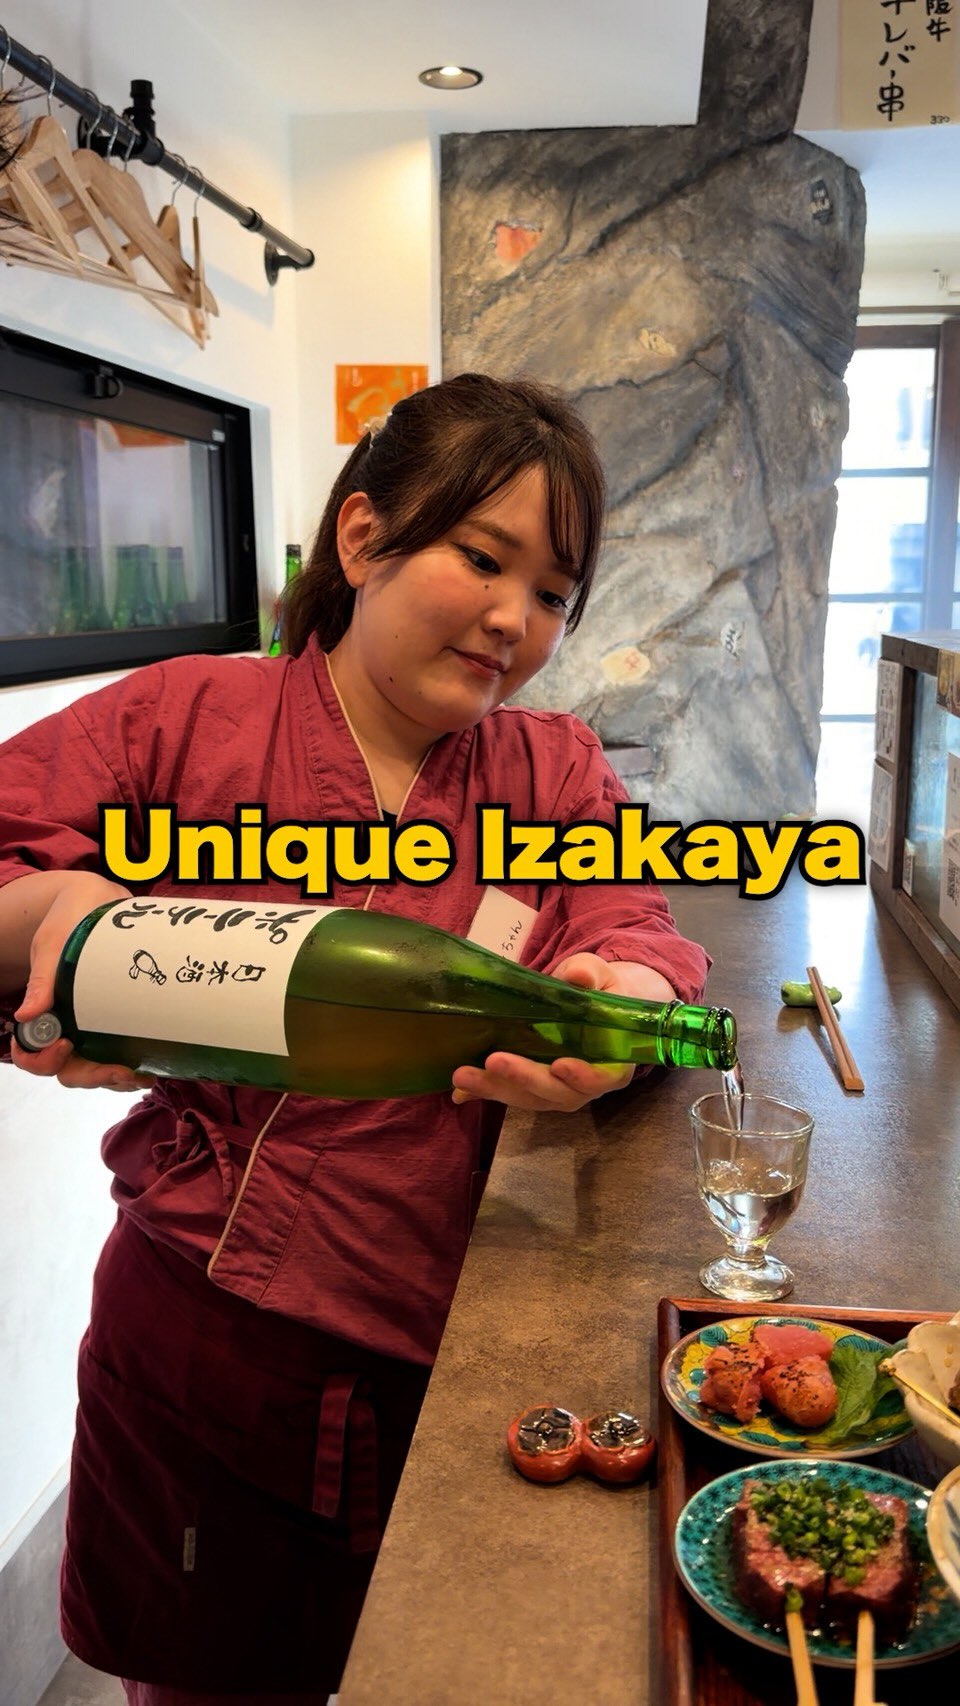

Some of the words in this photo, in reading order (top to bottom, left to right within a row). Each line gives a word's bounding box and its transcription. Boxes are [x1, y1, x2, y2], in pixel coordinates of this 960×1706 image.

[502, 920, 523, 958] ちゃん
[176, 955, 266, 985] 日本酒
